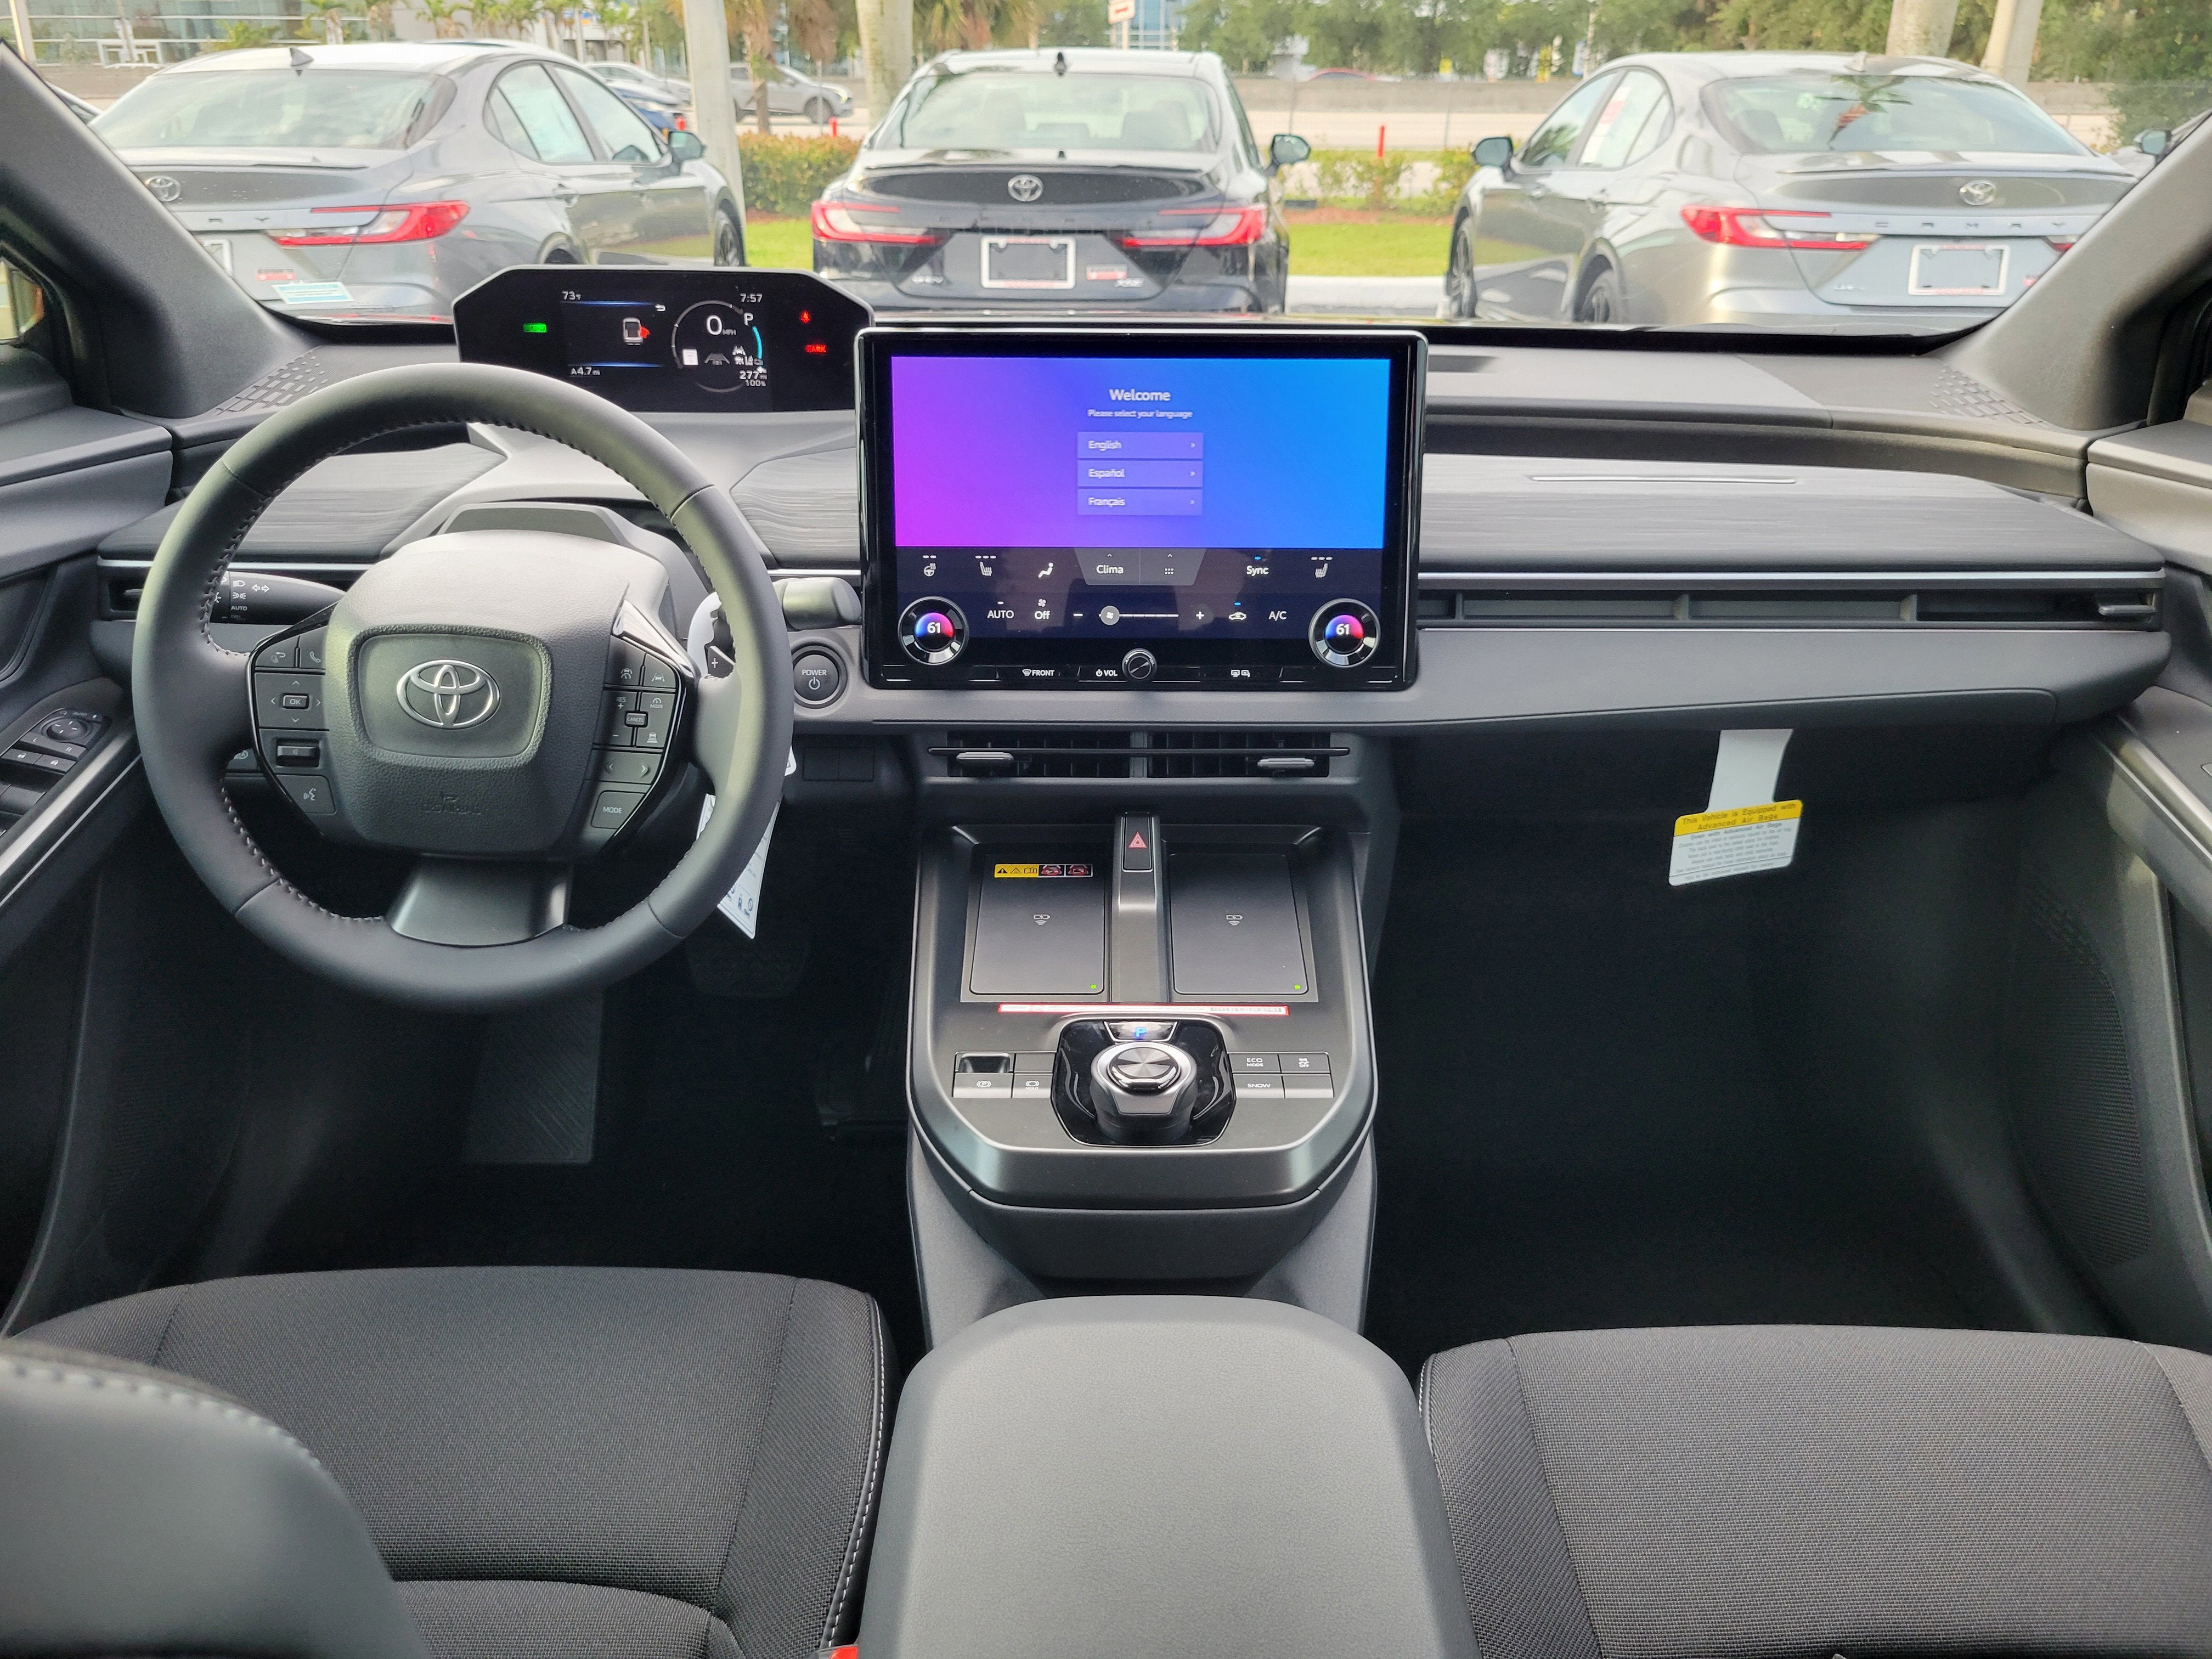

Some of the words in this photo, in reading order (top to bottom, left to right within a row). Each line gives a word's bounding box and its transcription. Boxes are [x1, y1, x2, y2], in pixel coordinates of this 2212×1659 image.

[740, 293, 763, 303] 7:57
[743, 312, 754, 325] P
[706, 315, 723, 335] 0
[1109, 389, 1171, 401] Welcome
[1155, 410, 1193, 419] language
[1088, 441, 1122, 452] English
[1088, 469, 1125, 479] Español
[1088, 497, 1126, 508] Français
[1096, 565, 1125, 574] Clima
[1246, 566, 1269, 577] Sync
[988, 610, 1014, 619] AUTO
[1035, 611, 1051, 620] Off
[1268, 611, 1287, 620] A/C
[927, 622, 941, 634] 61
[1335, 623, 1350, 635] 61
[1701, 812, 1728, 822] Vehicle
[1742, 805, 1777, 816] Equipped
[1696, 820, 1736, 831] Advanced
[1758, 814, 1778, 822] Bags
[1134, 1027, 1147, 1040] P
